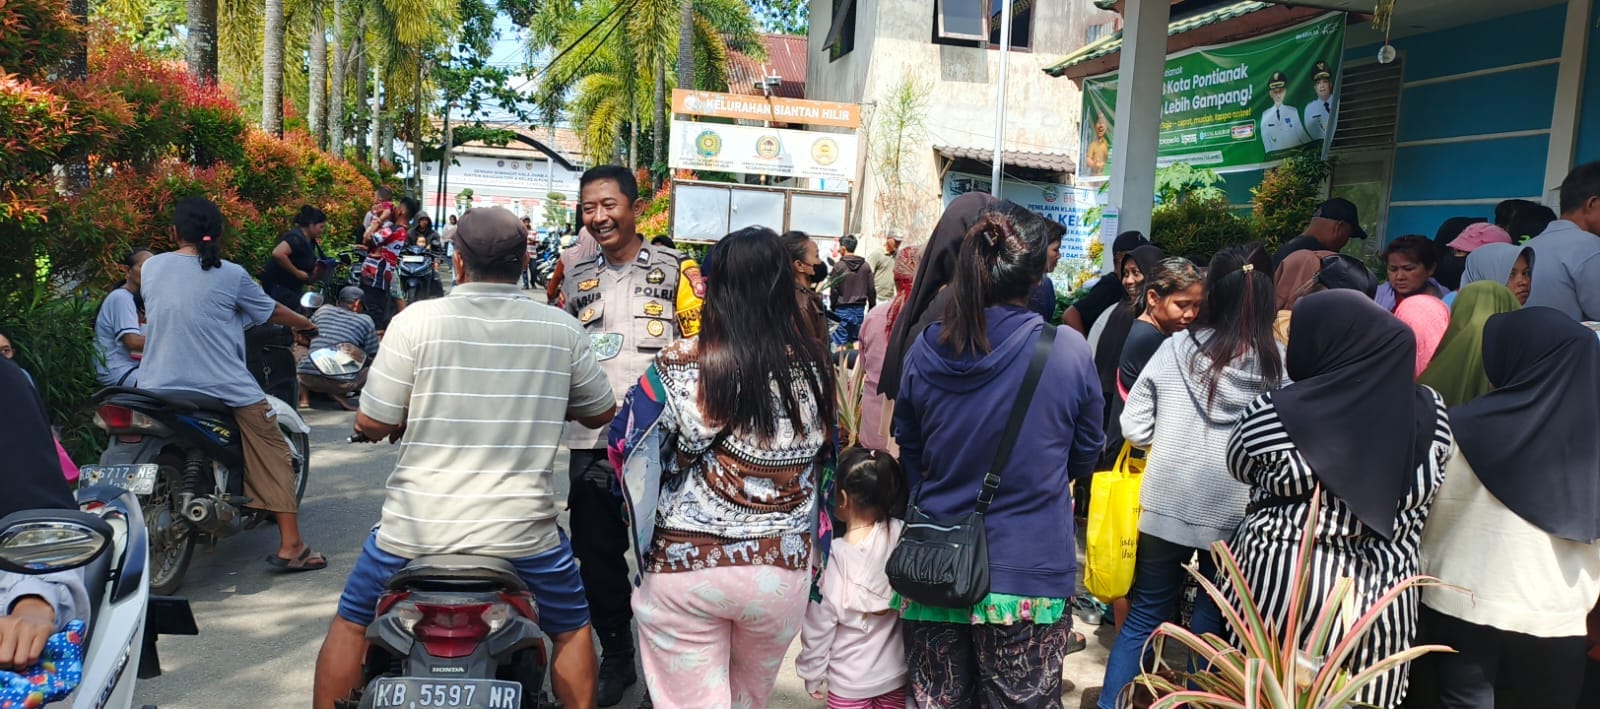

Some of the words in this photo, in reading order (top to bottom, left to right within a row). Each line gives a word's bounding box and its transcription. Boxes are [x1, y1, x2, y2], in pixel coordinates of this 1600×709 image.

[1167, 78, 1191, 93] Kota
[1193, 63, 1248, 88] Pontianak
[706, 98, 771, 115] KELURAHAN
[775, 106, 819, 118] SIANTAN
[822, 108, 850, 121] HILIR
[1164, 97, 1190, 114] Lebih
[1192, 84, 1252, 110] Gampang!
[634, 286, 673, 299] POLRI
[99, 467, 130, 479] 6717
[377, 683, 407, 707] KB
[420, 684, 476, 706] 5597
[489, 686, 516, 708] NR
